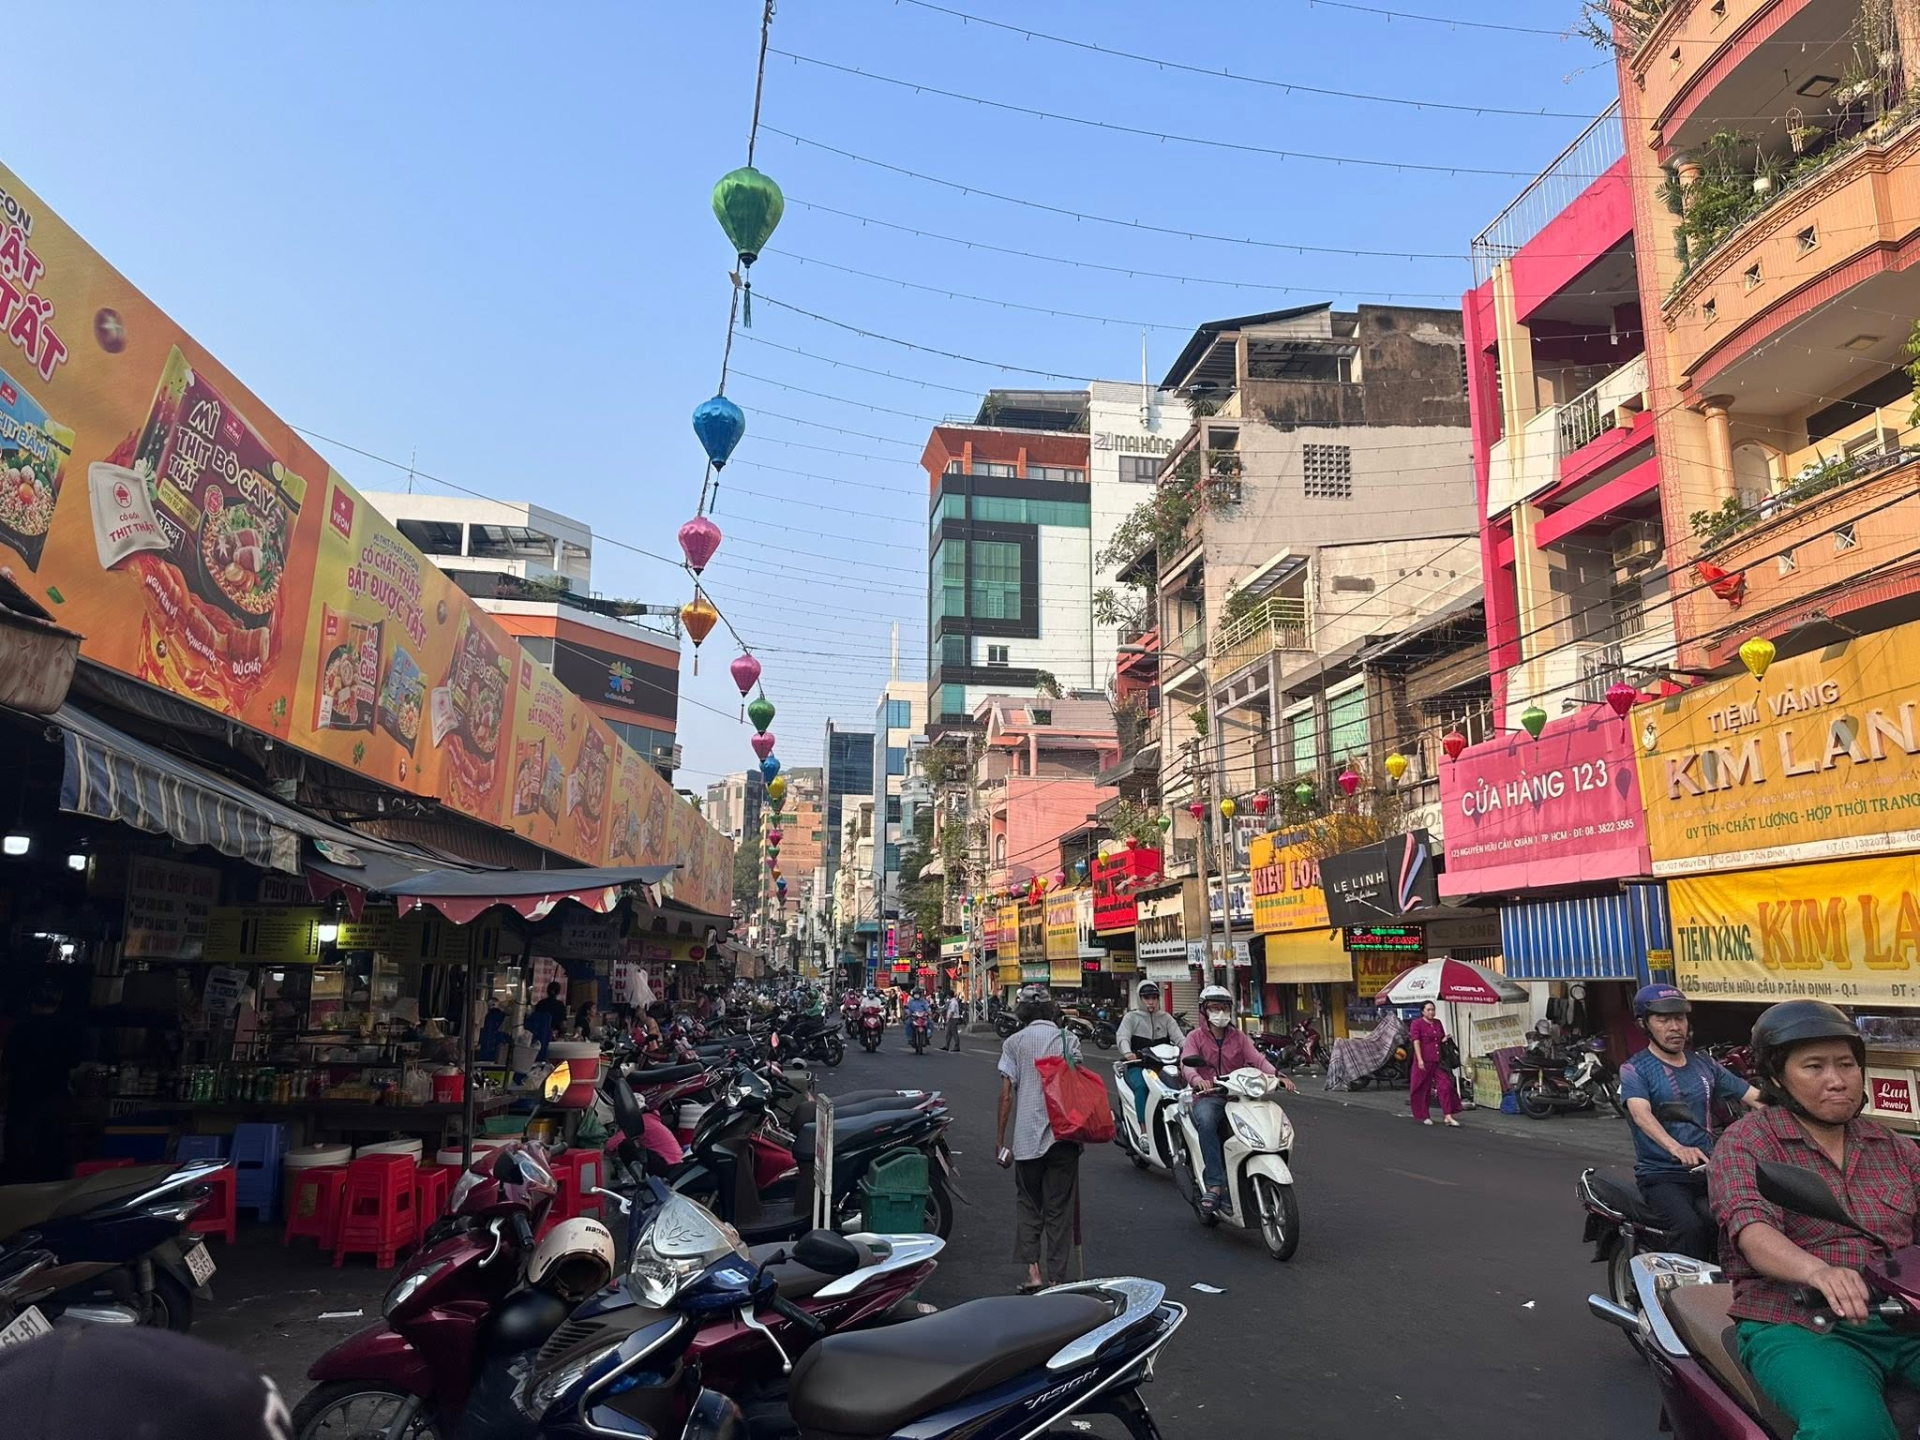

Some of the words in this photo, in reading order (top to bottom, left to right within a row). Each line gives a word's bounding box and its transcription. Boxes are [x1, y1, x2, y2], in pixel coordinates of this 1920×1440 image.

[189, 400, 219, 439] MÌ
[168, 454, 198, 492] THẬT
[177, 427, 212, 471] THỊT
[212, 446, 239, 484] BÒ
[238, 468, 276, 515] CAY
[109, 524, 133, 542] THỊT
[332, 509, 350, 533] VIFON
[362, 545, 374, 564] CÓ
[375, 552, 398, 576] CHẤT
[348, 565, 369, 599] BẬT
[370, 575, 405, 620] ĐƯỢC
[405, 604, 427, 650] TẤT
[360, 660, 377, 685] Cua
[1708, 703, 1761, 735] TIỆM
[1767, 680, 1840, 717] VÀNG
[1664, 737, 1766, 800] KIM
[1777, 702, 1920, 778] LAN
[1461, 777, 1502, 816] CỬA
[1506, 771, 1565, 808] HÀNG
[1572, 759, 1609, 793] 123
[1551, 830, 1567, 841] HCM
[1598, 821, 1615, 834] 3822
[1616, 818, 1635, 831] 3585
[1686, 826, 1699, 840] UY
[1758, 811, 1799, 831] LƯỢNG
[1806, 804, 1832, 824] HỢP
[1835, 798, 1868, 818] THỜI
[1869, 792, 1920, 813] TRANG
[1333, 881, 1348, 893] LE
[1352, 871, 1385, 889] LINH
[1678, 916, 1712, 970] TIỆM
[1712, 915, 1754, 961] VÀNG
[1757, 896, 1852, 970] KIM
[1680, 974, 1700, 992] 125
[1701, 976, 1735, 993] NGUYỄN
[1737, 979, 1755, 993] HỮU
[1757, 977, 1776, 993] CẦU
[1808, 982, 1832, 997] ĐỊNH
[1842, 983, 1858, 997] Q.1
[1891, 984, 1907, 996] ĐT
[1878, 1083, 1908, 1099] Lan
[1881, 1099, 1909, 1111] Jewelry
